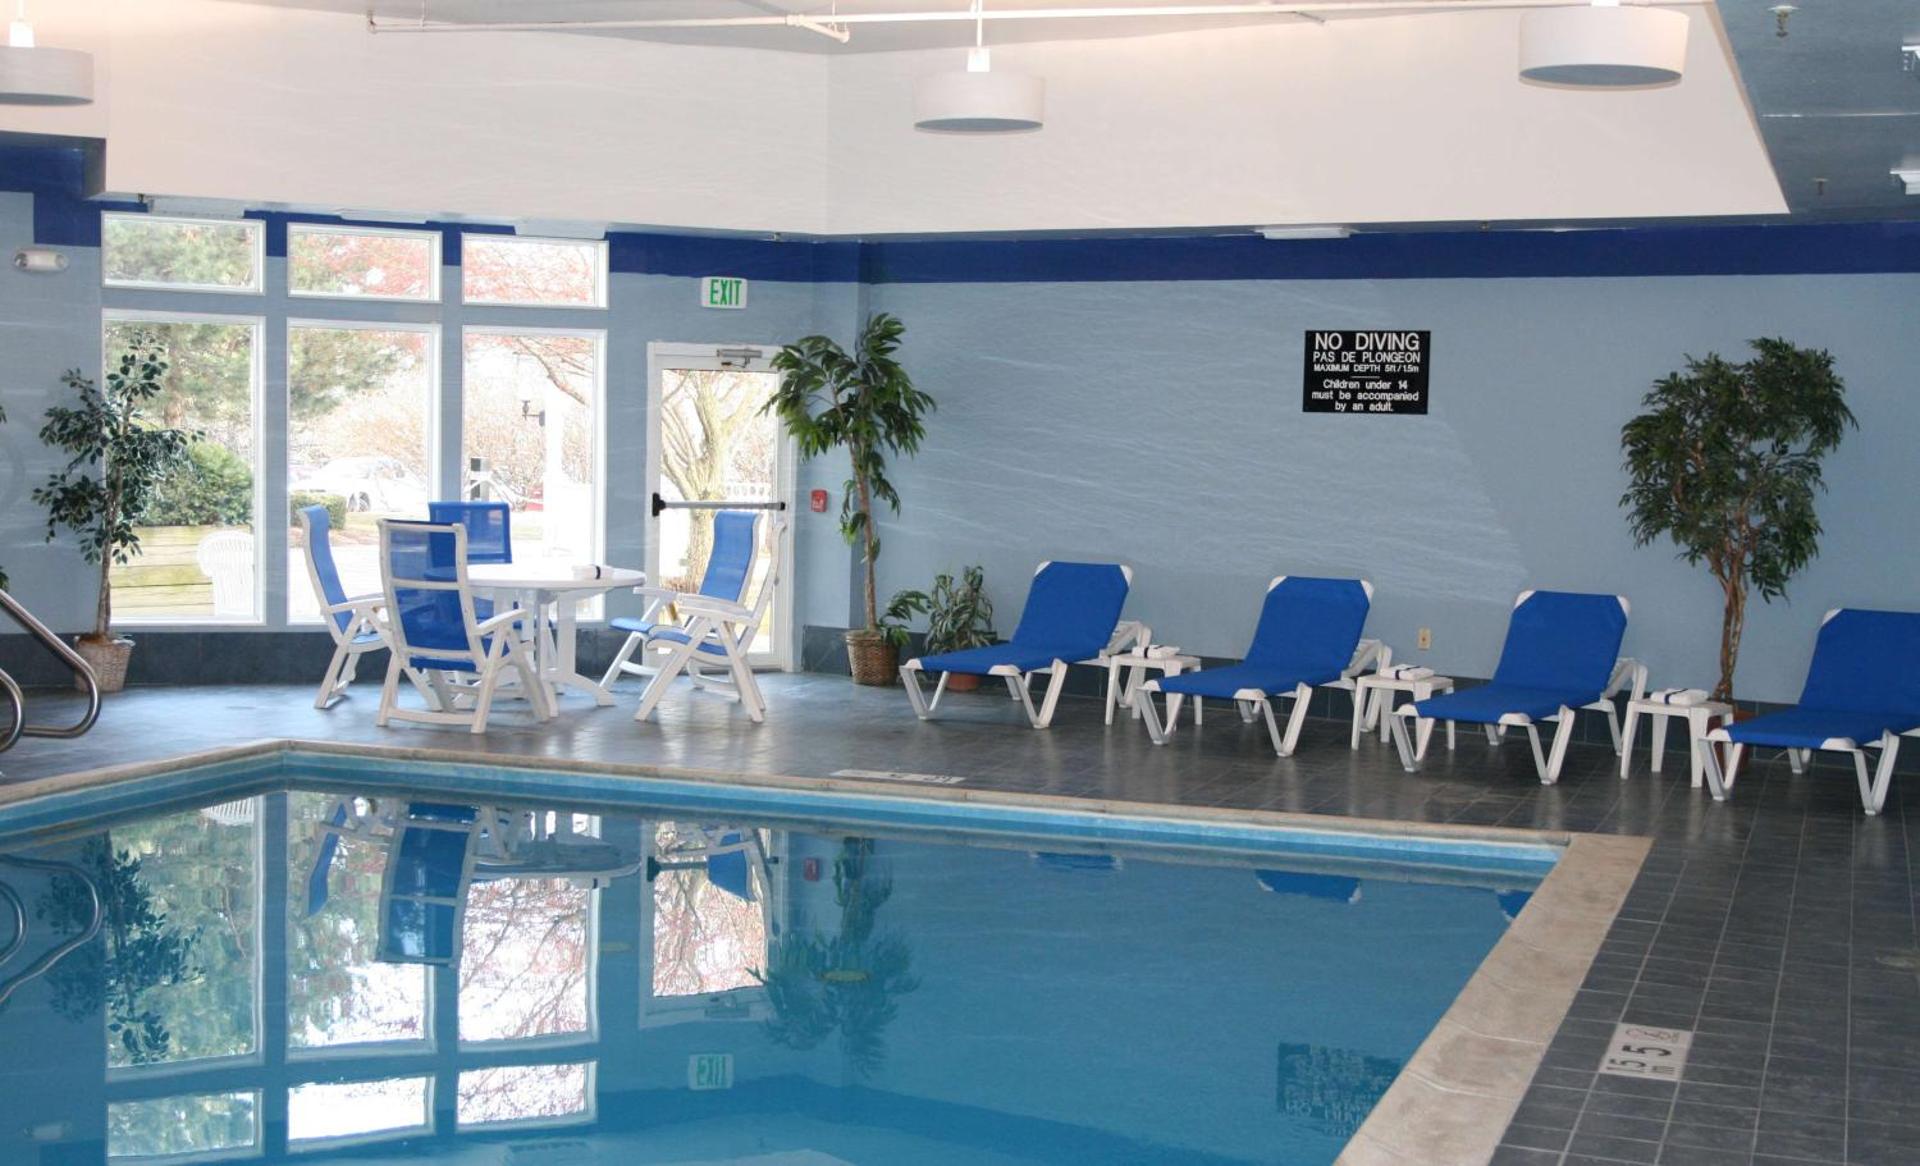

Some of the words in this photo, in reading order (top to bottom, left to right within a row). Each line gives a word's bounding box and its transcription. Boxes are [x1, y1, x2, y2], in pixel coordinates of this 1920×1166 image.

[710, 279, 742, 305] EXIT
[1315, 333, 1342, 350] NO
[1355, 333, 1420, 350] DIVING
[1313, 351, 1335, 362] PAS
[1341, 351, 1356, 362] DE
[1362, 352, 1420, 363] PLONGEON
[1313, 364, 1350, 372] MAXIMUM
[1353, 364, 1380, 372] DEPTH
[1323, 379, 1360, 389] Children
[1365, 380, 1392, 389] under
[1398, 380, 1408, 389] 14
[1311, 390, 1334, 400] must
[1339, 390, 1351, 400] be
[1357, 391, 1419, 401] accompanied
[1335, 401, 1347, 411] by
[1352, 402, 1364, 411] an
